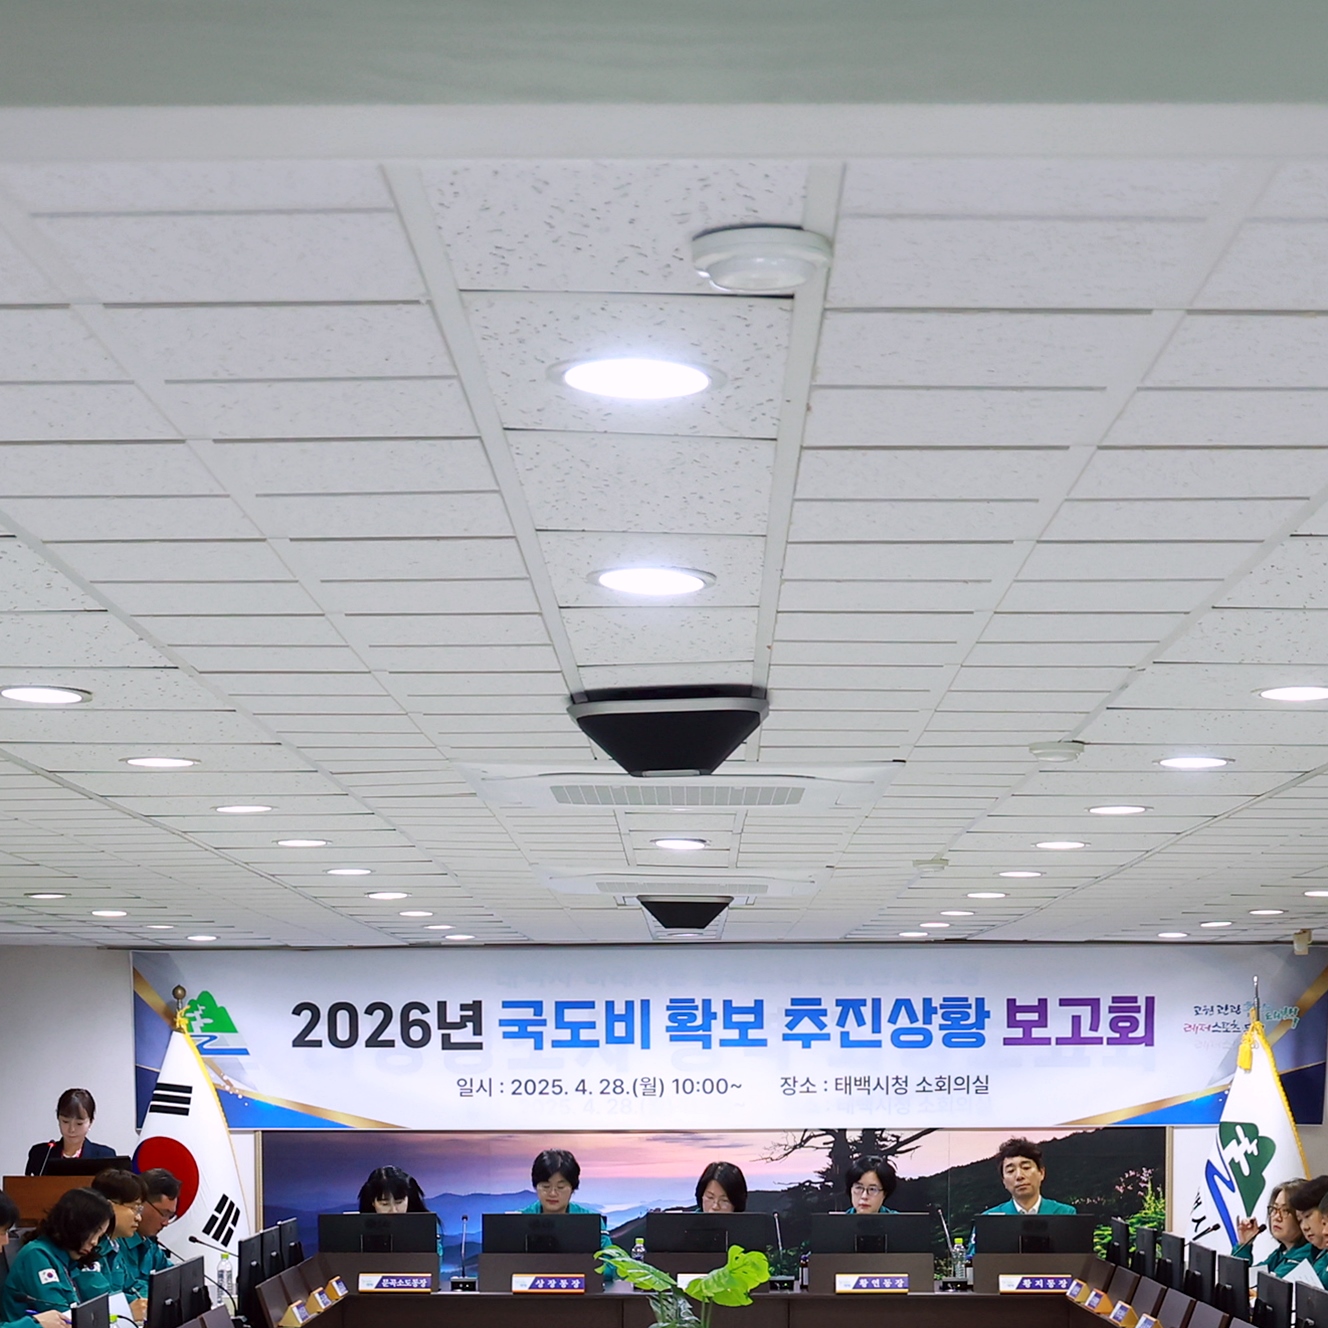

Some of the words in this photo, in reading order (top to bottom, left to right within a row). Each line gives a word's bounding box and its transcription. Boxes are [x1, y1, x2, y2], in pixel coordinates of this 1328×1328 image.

[290, 999, 484, 1051] 2026년
[497, 998, 651, 1051] 국도비
[665, 997, 768, 1050] 확보
[781, 996, 992, 1050] 추진상황
[1002, 995, 1156, 1047] 보고회
[456, 1077, 492, 1098] 일시
[511, 1078, 569, 1096] 2025.
[574, 1078, 591, 1095] 4.
[599, 1076, 665, 1098] 28.(월)
[672, 1077, 742, 1095] 10:00~
[780, 1075, 817, 1096] 장소
[834, 1074, 909, 1096] 태백시청
[915, 1074, 989, 1095] 소회의실
